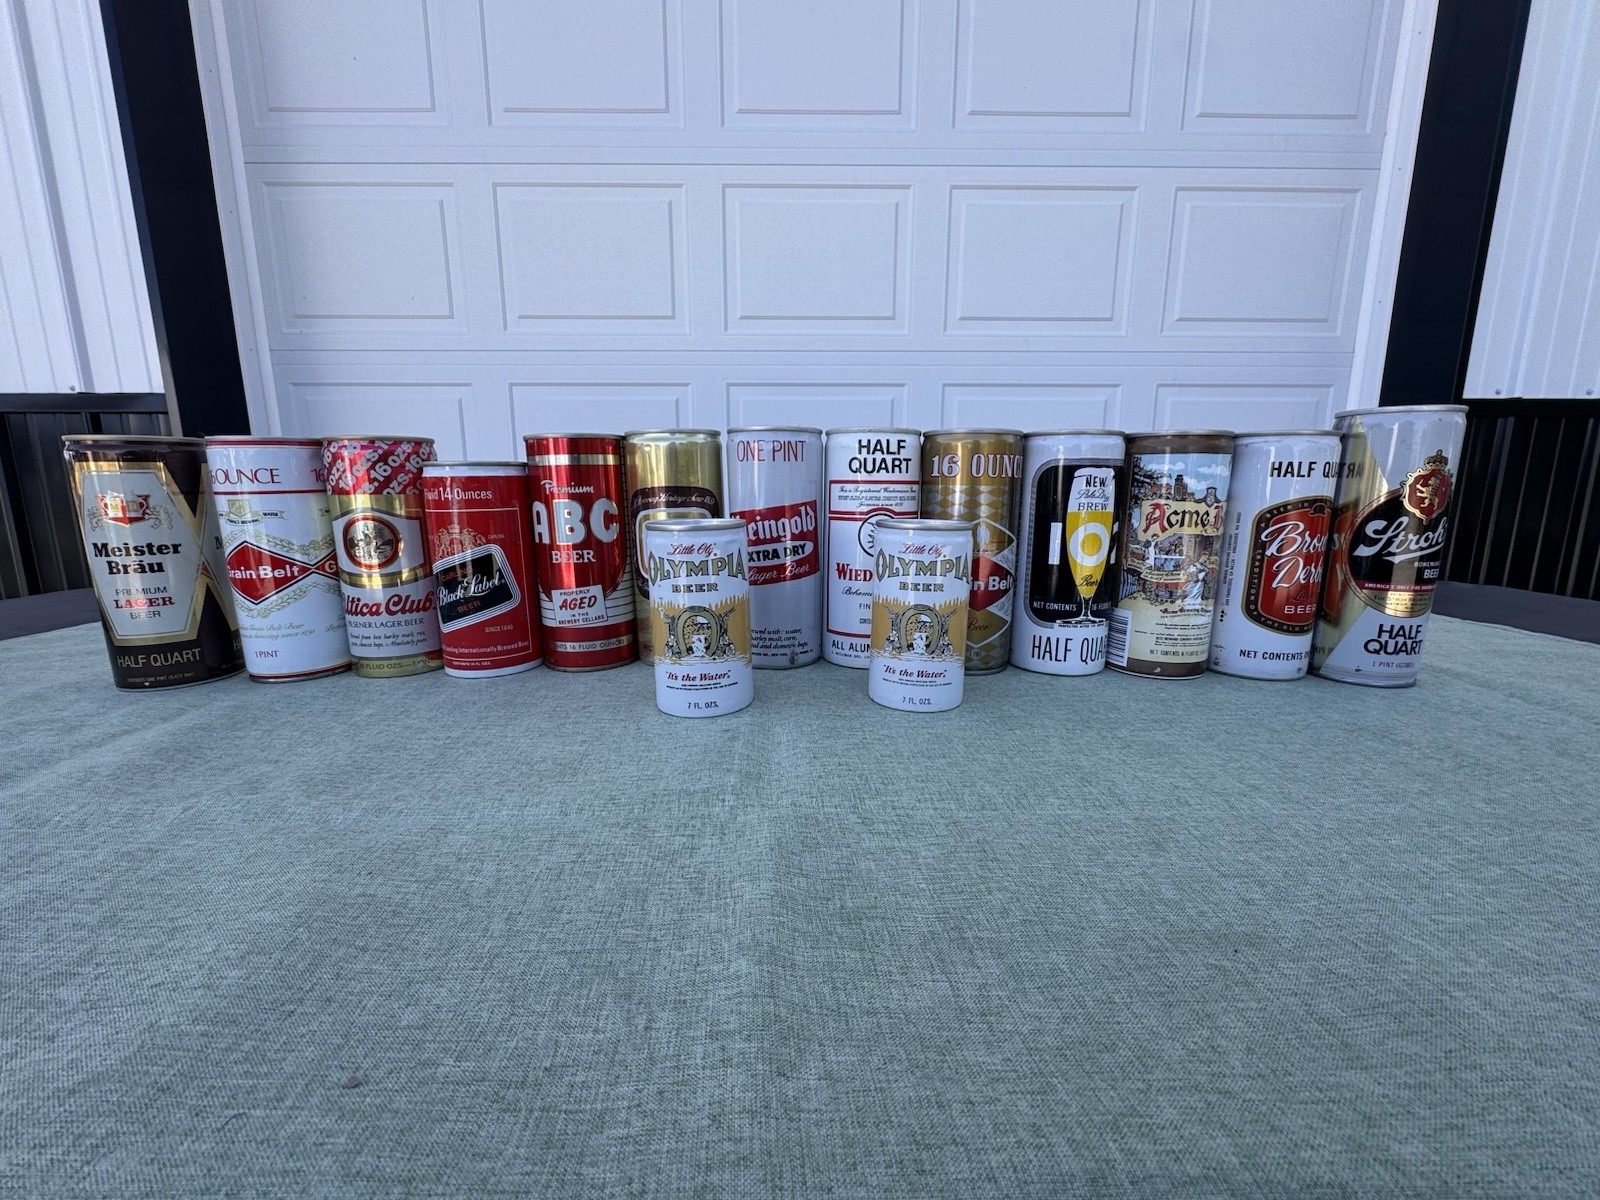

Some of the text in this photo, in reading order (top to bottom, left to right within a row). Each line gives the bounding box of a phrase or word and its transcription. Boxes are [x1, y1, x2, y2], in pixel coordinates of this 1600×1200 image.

[736, 440, 806, 462] ONE PINT
[858, 439, 907, 455] HALF
[370, 462, 392, 482] 16
[848, 457, 912, 474] QUART
[931, 452, 1023, 479] 16 OUNC
[1269, 461, 1317, 478] HALF
[215, 468, 282, 484] OUNCE
[1085, 475, 1108, 488] NEW
[439, 487, 453, 501] 14
[454, 488, 493, 499] Ounces
[541, 479, 594, 495] Premium
[1077, 502, 1109, 511] BREW
[532, 498, 619, 545] ABC
[747, 505, 816, 541] eingold
[1141, 502, 1210, 534] Acme
[92, 542, 182, 557] Meister
[551, 549, 597, 564] BEER
[747, 543, 807, 563] XTRA DRY
[106, 560, 165, 575] Bräu
[258, 565, 299, 579] Belt
[648, 548, 747, 586] OLYMPIA
[781, 562, 811, 577] Beer
[875, 548, 970, 585] OLYMPIA
[1271, 555, 1323, 590] Derb
[1423, 568, 1439, 579] BEE
[671, 583, 719, 593] BEER
[899, 582, 944, 592] BEER
[988, 575, 1012, 590] Bel
[1078, 574, 1099, 587] Beer
[115, 586, 168, 596] PREMIUM
[437, 571, 500, 607] Black Label
[842, 586, 873, 597] Bohemi
[113, 596, 175, 609] LAGER
[457, 600, 481, 612] BEER
[559, 595, 598, 610] AGED
[1045, 602, 1077, 611] CONTENTS
[1284, 604, 1317, 614] BEER
[130, 610, 162, 620] BEER
[375, 620, 403, 628] LAGER
[405, 618, 425, 626] BEER
[485, 625, 500, 633] SINCE
[967, 616, 990, 631] Beer
[1377, 624, 1422, 640] HALF
[497, 642, 518, 651] Brewed
[831, 639, 845, 650] ALL
[1031, 634, 1073, 663] HALF
[1080, 637, 1105, 665] QUA
[1363, 638, 1423, 655] QUART
[116, 648, 201, 668] HALF QUART
[259, 650, 279, 658] PINT
[1239, 649, 1259, 659] NET
[1262, 651, 1303, 661] CONTENTS
[681, 673, 697, 682] the
[899, 669, 914, 678] the
